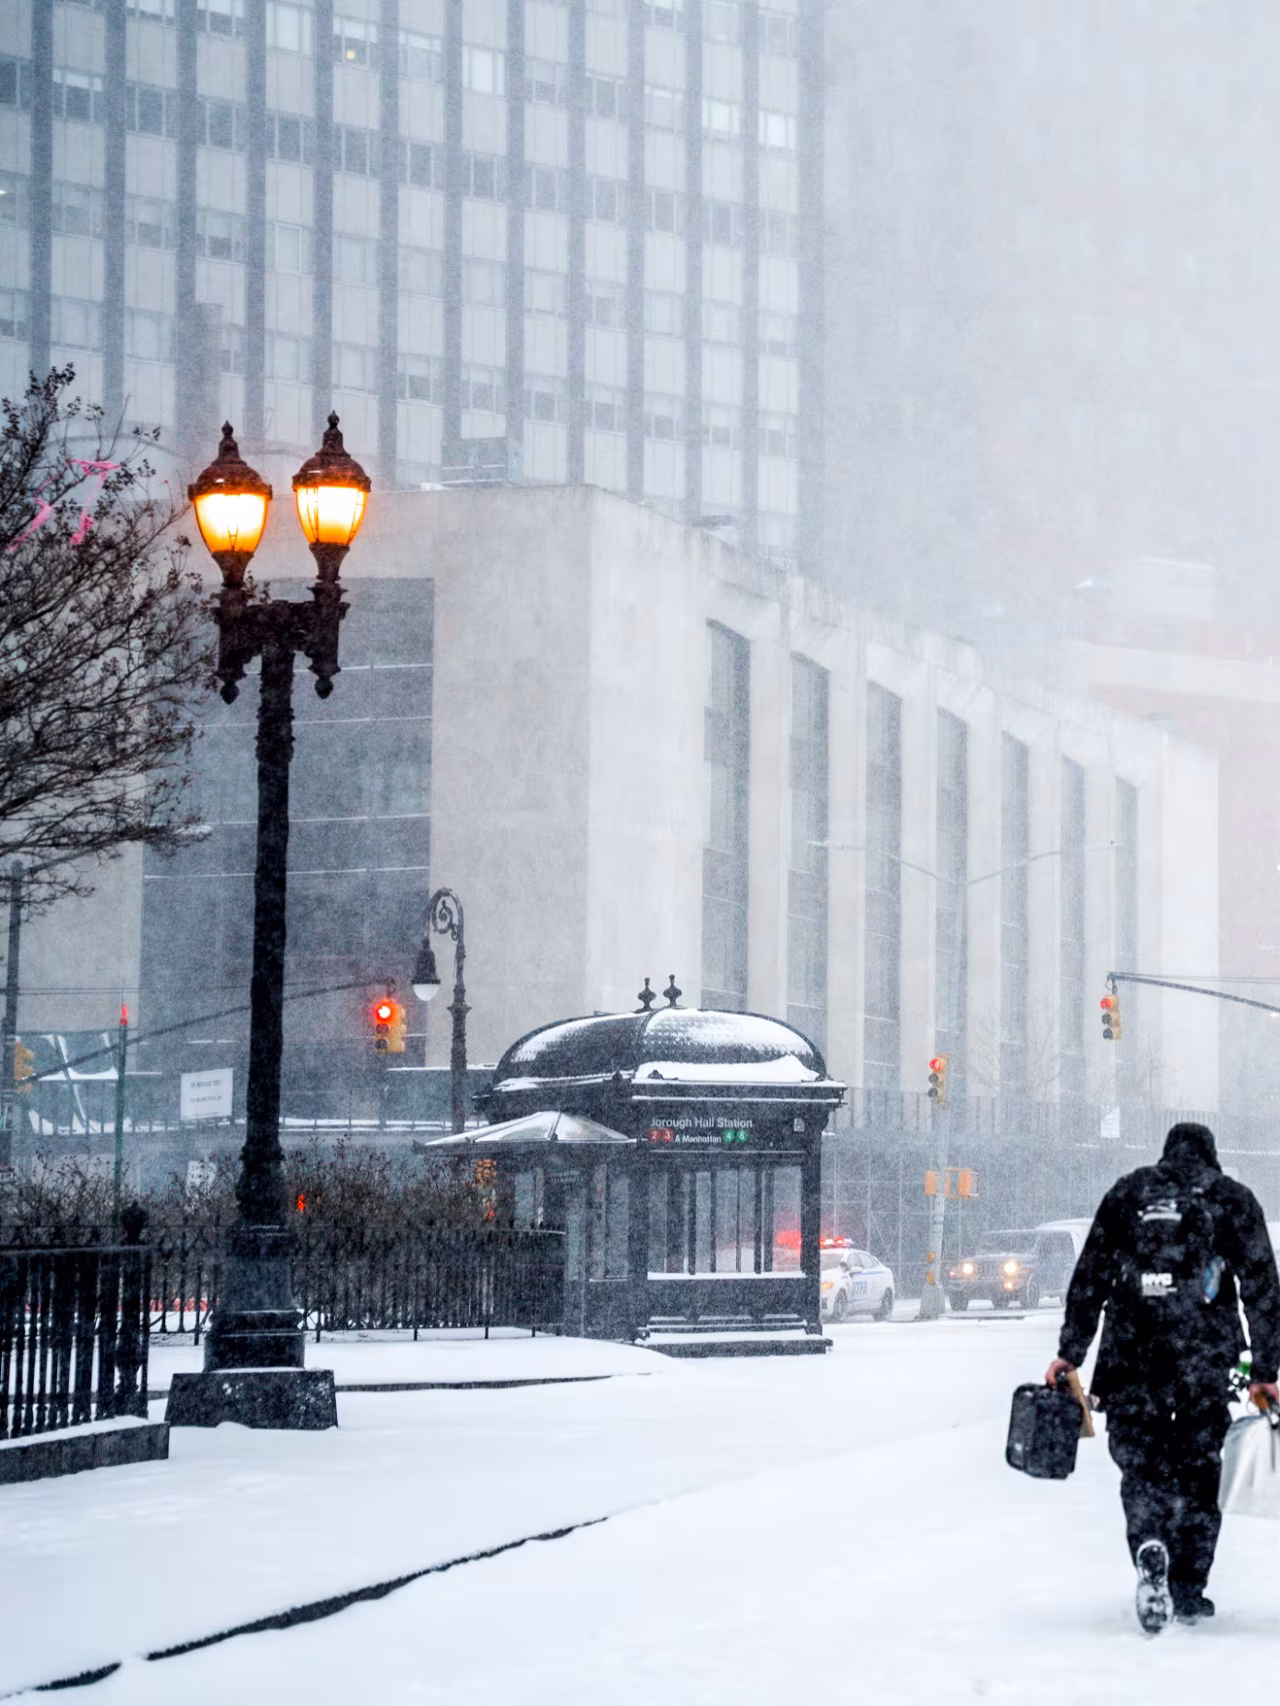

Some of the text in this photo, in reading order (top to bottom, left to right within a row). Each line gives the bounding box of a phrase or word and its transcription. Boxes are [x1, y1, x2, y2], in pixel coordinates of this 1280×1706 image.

[695, 1116, 714, 1128] Hall
[717, 1117, 753, 1128] Station
[675, 1134, 680, 1142] &
[682, 1134, 721, 1143] Manhattan
[1141, 1273, 1172, 1286] NYC
